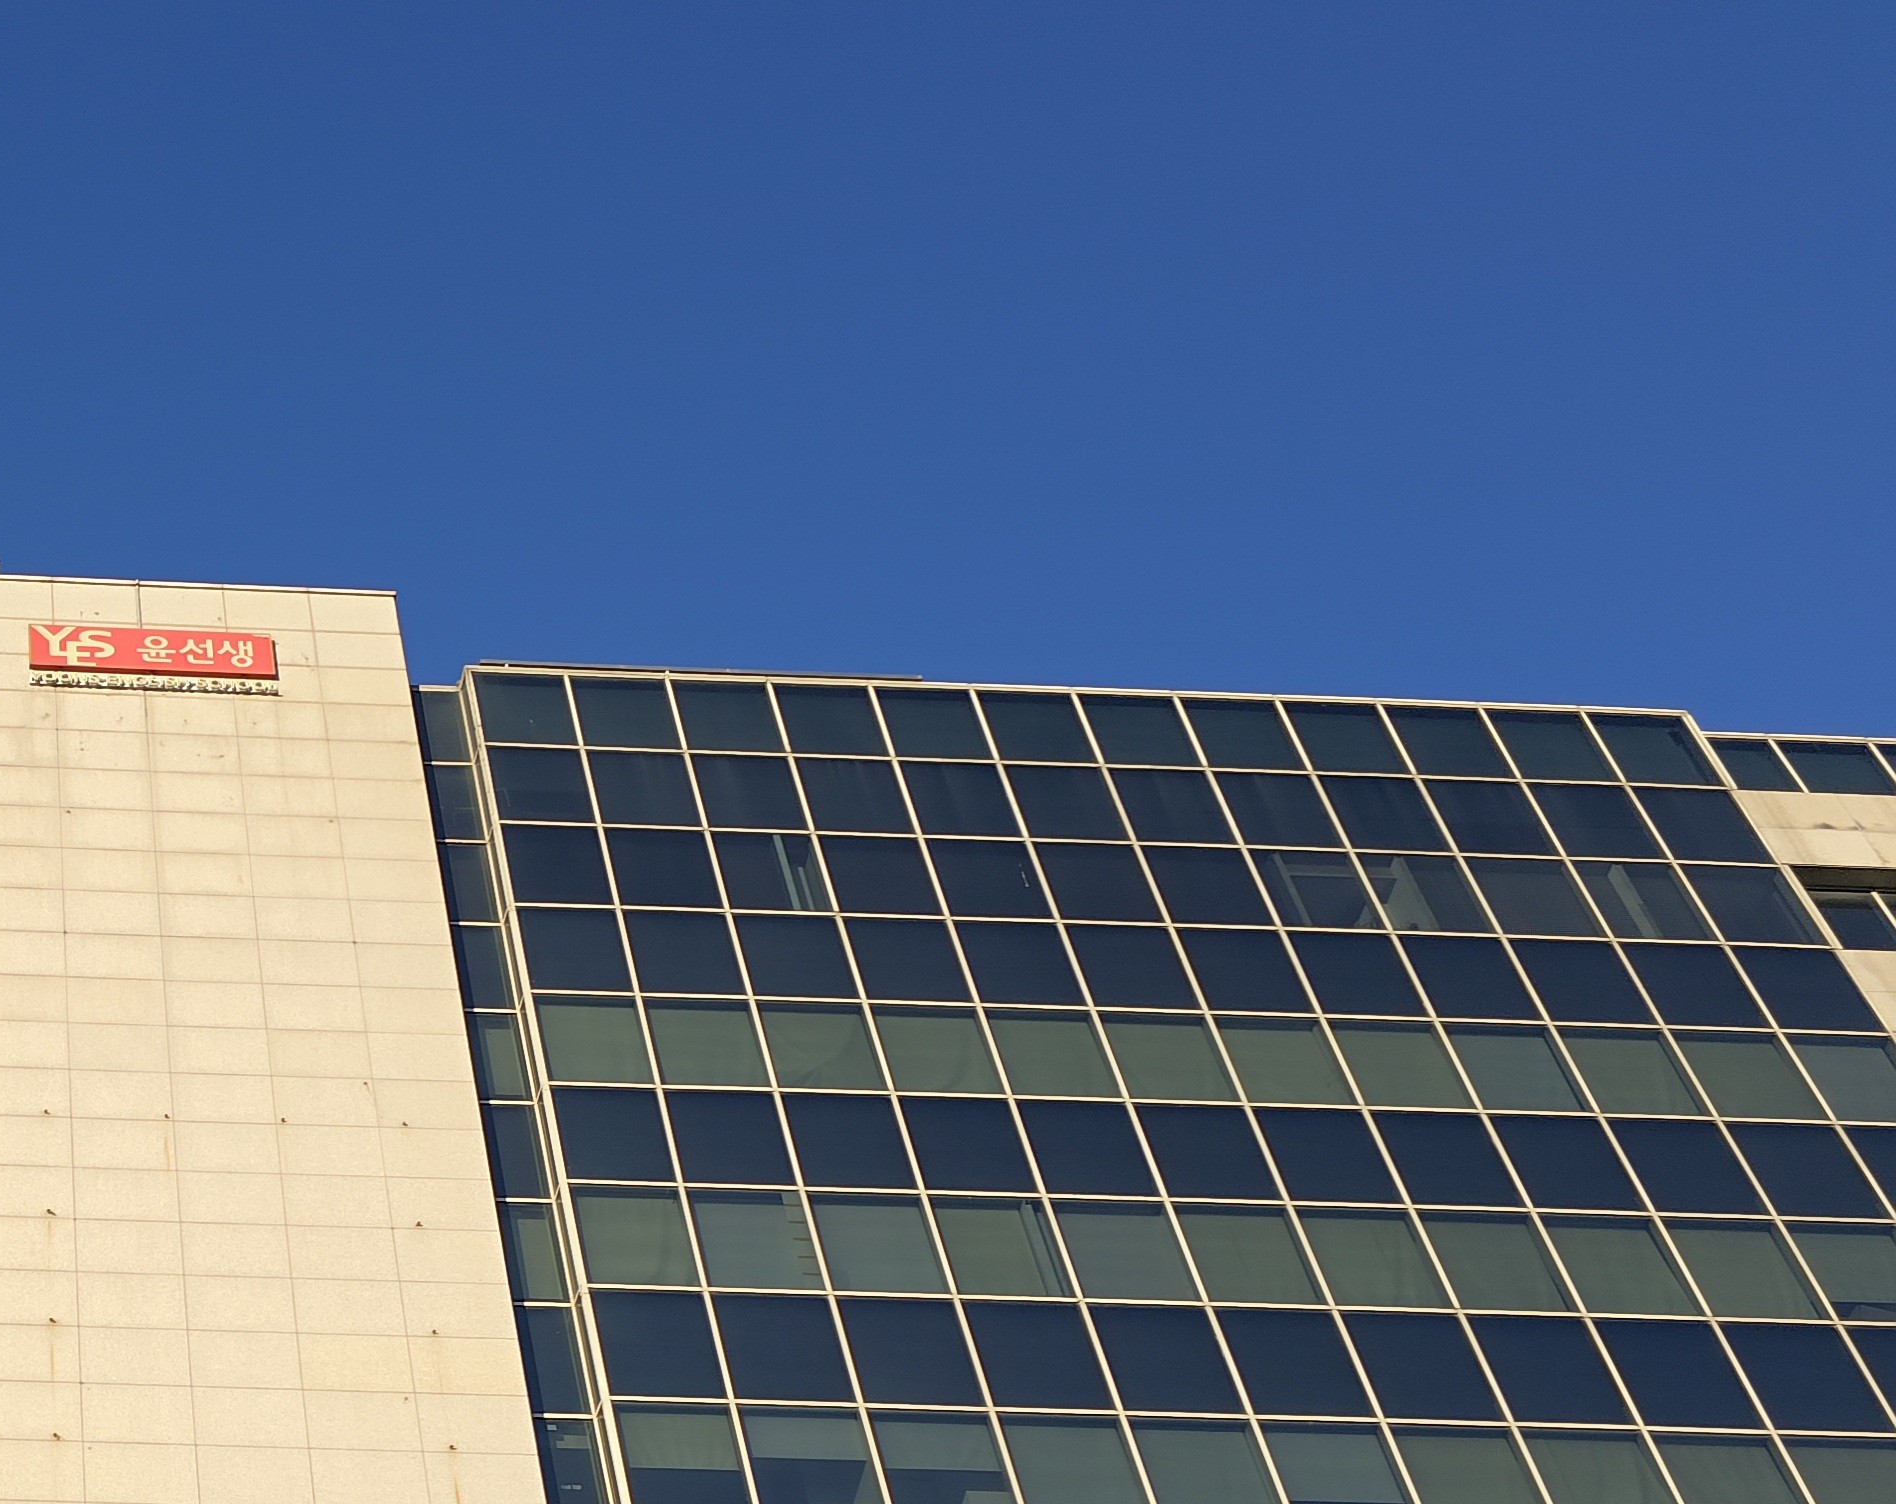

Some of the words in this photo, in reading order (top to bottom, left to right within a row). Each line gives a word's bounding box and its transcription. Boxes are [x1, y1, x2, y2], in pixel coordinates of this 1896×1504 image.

[136, 635, 254, 668] 윤선생
[106, 675, 190, 691] ENGLISH
[195, 679, 279, 695] SCHOOL
